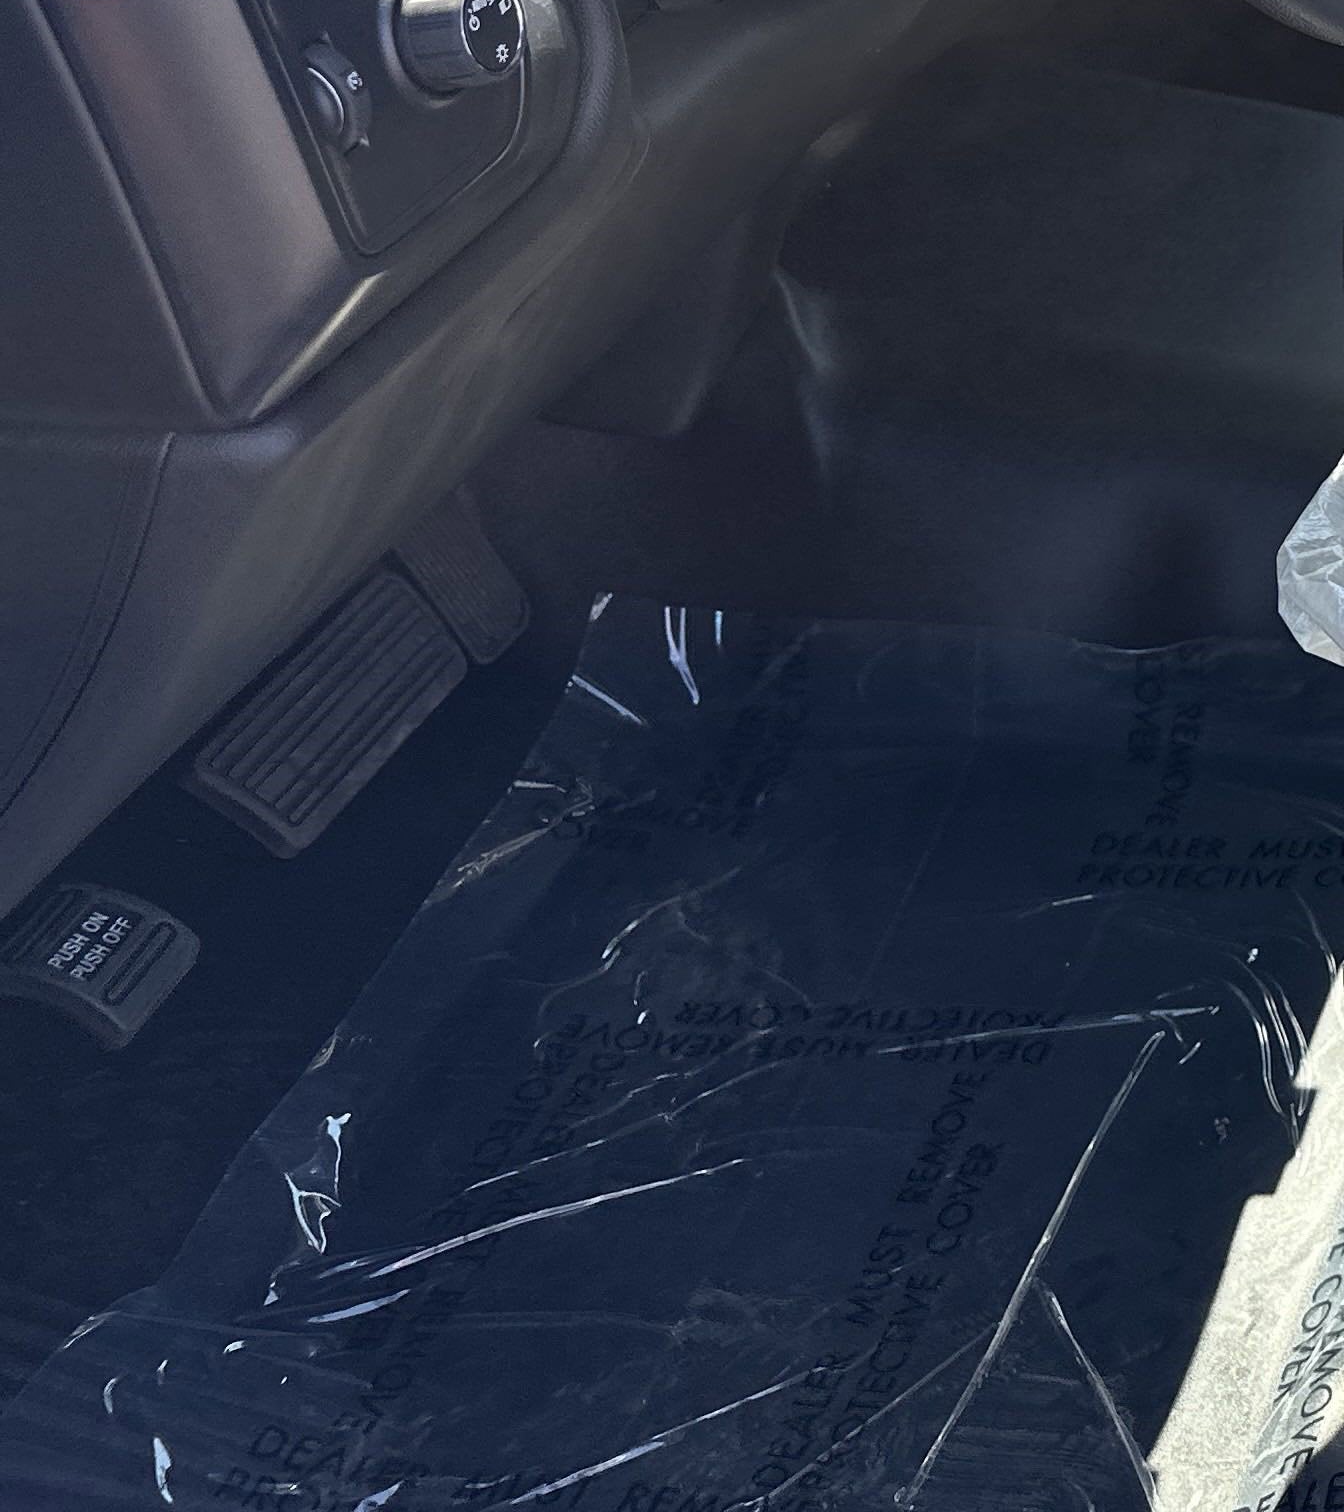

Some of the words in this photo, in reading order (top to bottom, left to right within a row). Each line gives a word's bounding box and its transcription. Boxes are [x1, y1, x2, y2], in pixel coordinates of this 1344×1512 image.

[1091, 832, 1228, 860] DEALER
[1076, 863, 1299, 889] PROTECTIVE
[47, 932, 91, 970] PUSH
[82, 911, 110, 935] ON
[70, 943, 113, 981] PUSH
[102, 916, 134, 945] OFF
